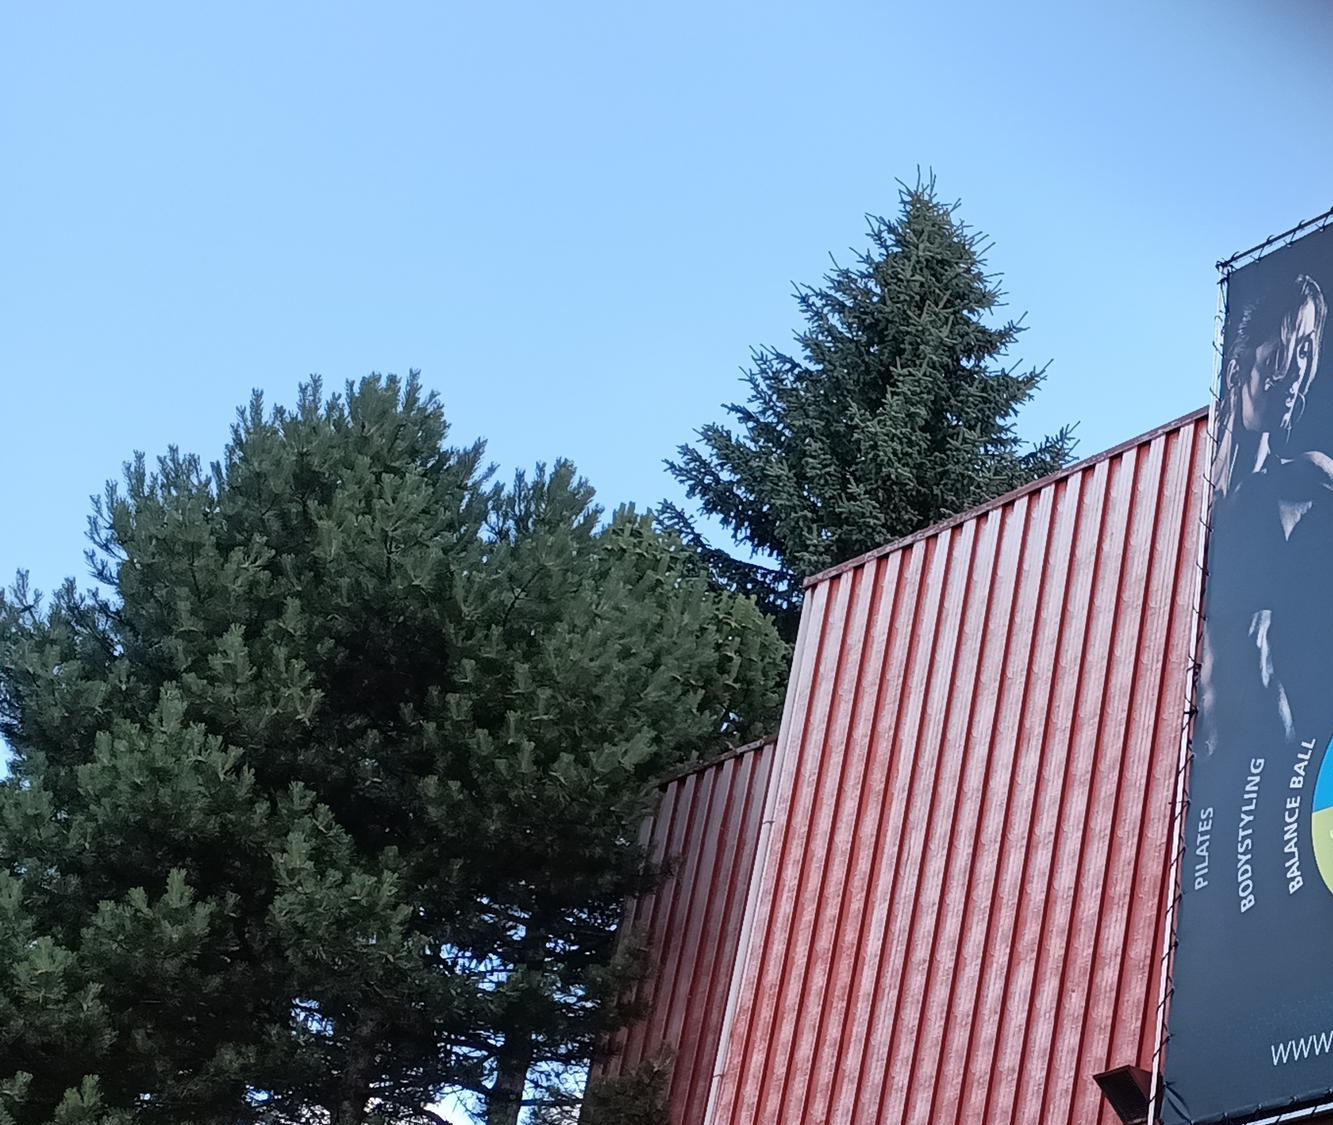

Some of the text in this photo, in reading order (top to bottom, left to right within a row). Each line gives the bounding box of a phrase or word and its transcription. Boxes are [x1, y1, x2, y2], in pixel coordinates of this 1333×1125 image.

[1195, 807, 1214, 890] PILATES
[1237, 758, 1265, 912] BODYSTYLING
[1284, 739, 1316, 894] BALANCE BALL
